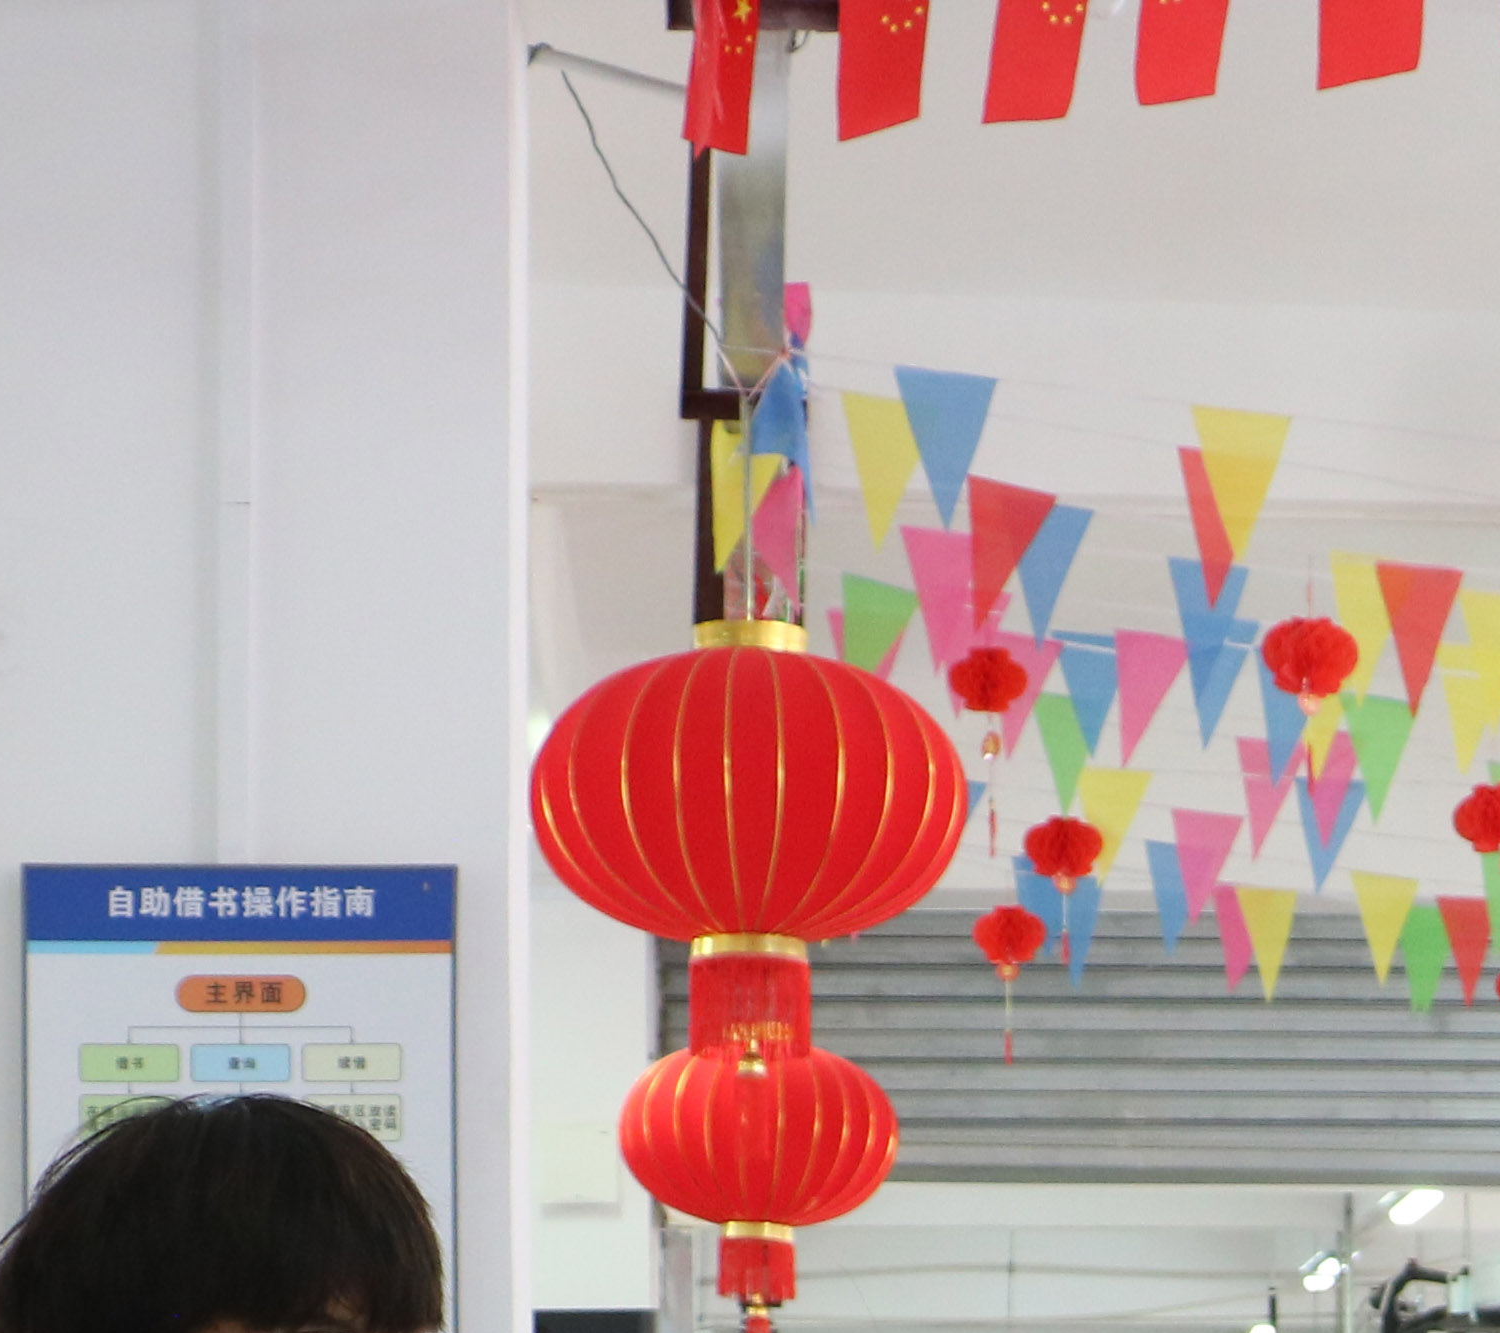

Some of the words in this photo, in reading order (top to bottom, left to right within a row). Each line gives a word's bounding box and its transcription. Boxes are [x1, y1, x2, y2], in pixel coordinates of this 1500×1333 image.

[106, 885, 377, 920] 自助借书操作指南
[206, 980, 283, 1006] 主界面
